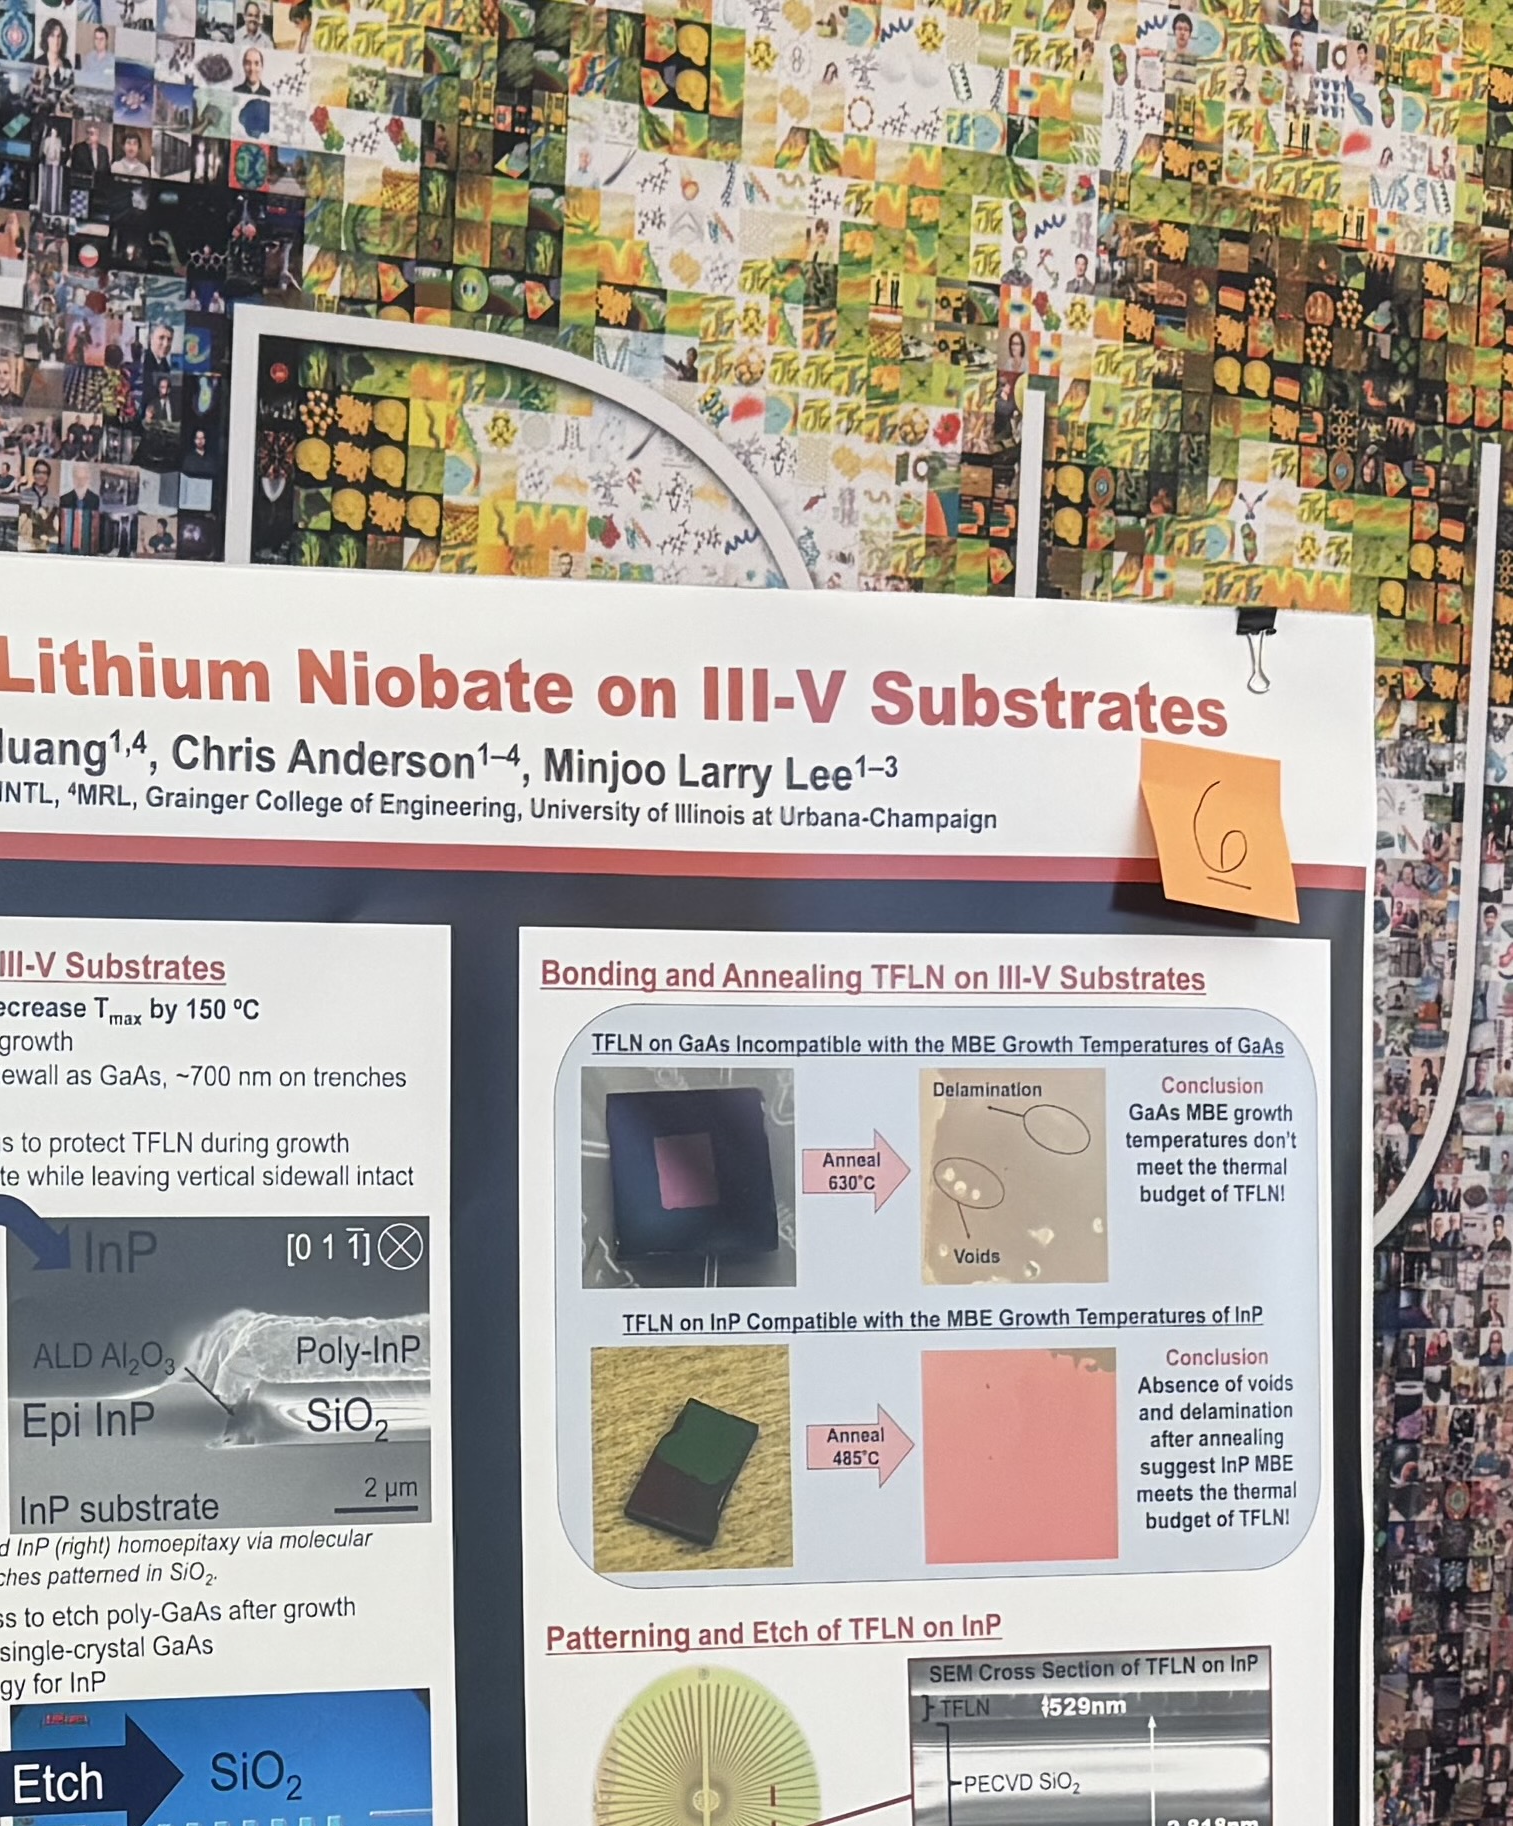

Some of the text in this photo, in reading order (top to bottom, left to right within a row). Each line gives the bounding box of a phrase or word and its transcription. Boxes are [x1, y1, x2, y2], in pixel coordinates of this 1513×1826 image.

[297, 648, 574, 715] Niobate
[597, 674, 677, 720] on
[703, 665, 847, 725] III-V
[871, 669, 1228, 739] Substrates
[172, 733, 276, 774] Chris
[544, 747, 666, 795] Minjoo
[679, 752, 773, 800] Larry
[1193, 779, 1249, 875] 6
[0, 949, 57, 979] III-V
[65, 950, 226, 982] Substrates
[541, 958, 1206, 992] Bonding and Annealing TFLN on III-V Substrates
[933, 1080, 1042, 1098] Delamination
[1161, 1075, 1264, 1095] Conclusion
[822, 1150, 881, 1169] Anneal
[82, 1230, 159, 1274] InP
[953, 1247, 1001, 1265] Voids
[296, 1335, 422, 1368] Poly-InP
[22, 1401, 156, 1440] Epi InP
[19, 1492, 220, 1526] InP substrate
[547, 1612, 1002, 1652] Patterning and Etch of TFLN on InP
[32, 1671, 63, 1695] for
[70, 1670, 106, 1694] InP
[929, 1652, 1259, 1684] SEM Cross Section of TFLN on InP
[12, 1760, 104, 1805] Etch
